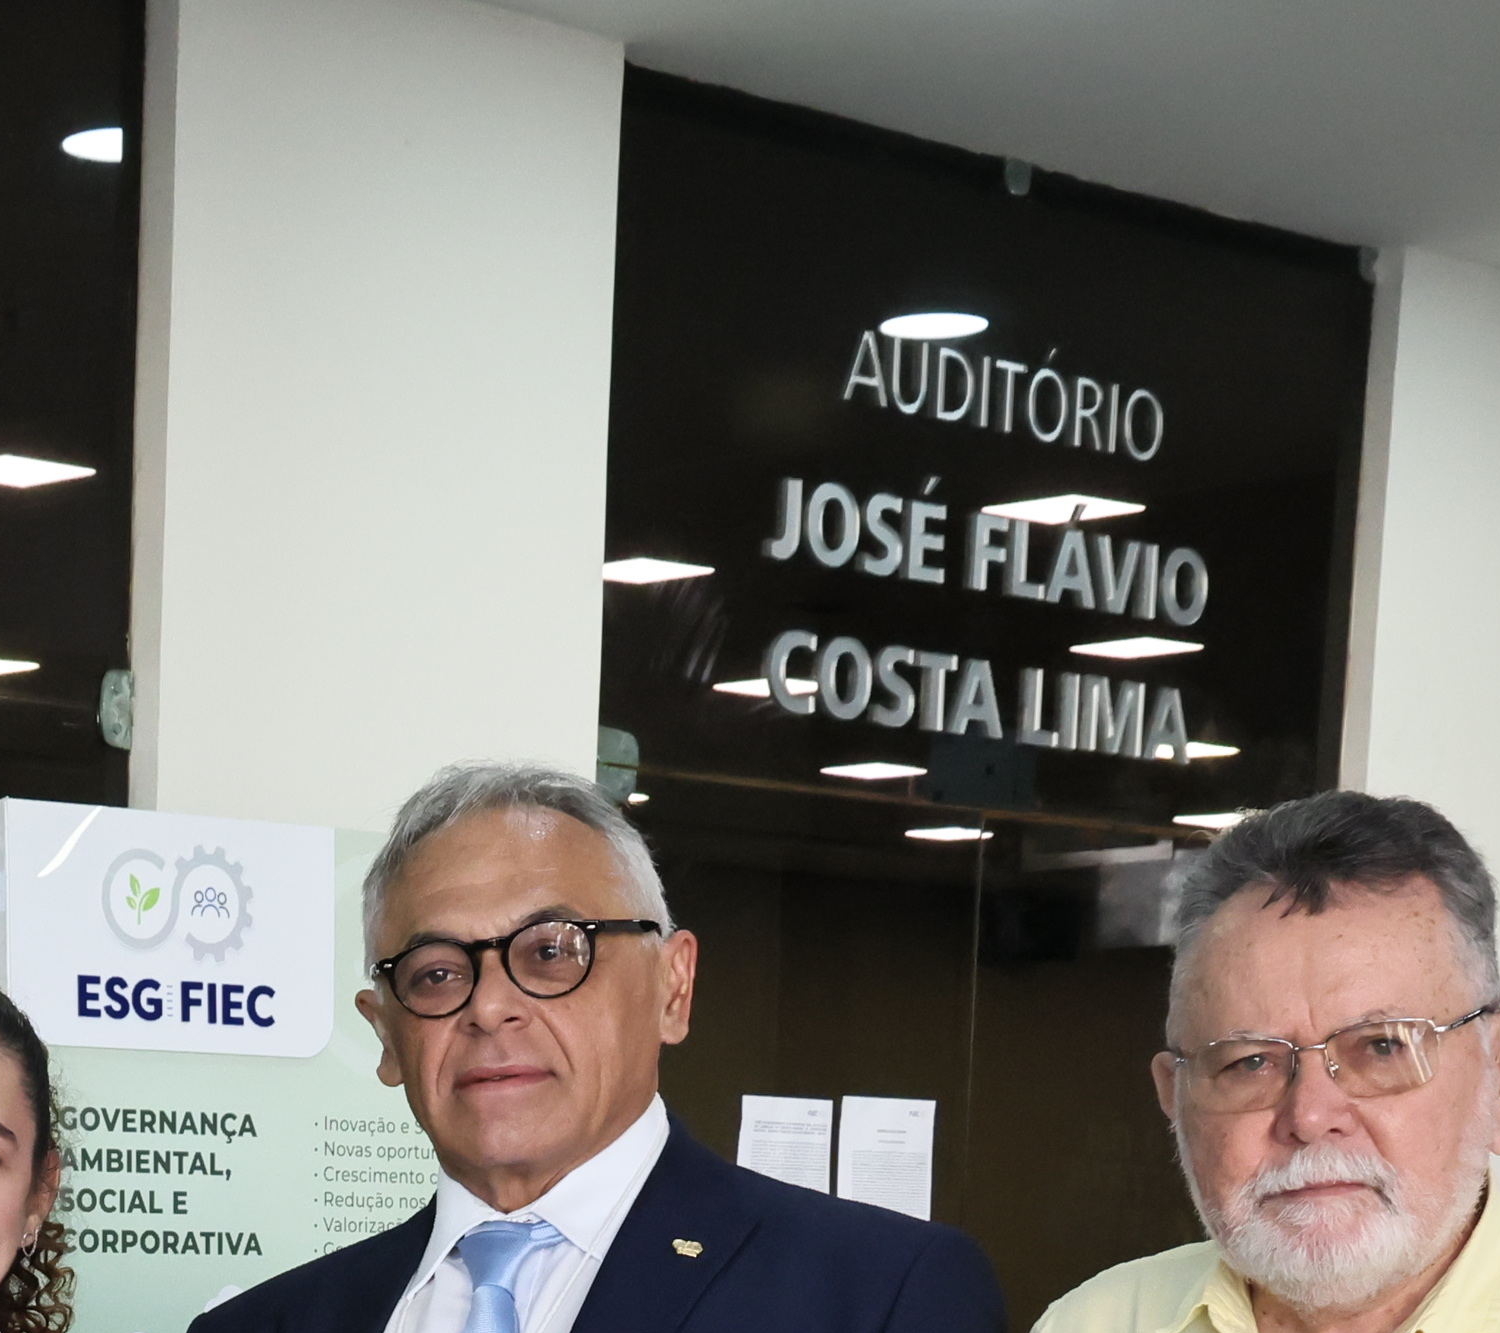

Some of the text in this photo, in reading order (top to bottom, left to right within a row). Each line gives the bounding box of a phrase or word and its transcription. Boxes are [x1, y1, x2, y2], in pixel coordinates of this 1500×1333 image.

[843, 330, 1165, 462] AUDITÓRIO
[763, 475, 1209, 627] JOSÉ FLÁVIO
[765, 629, 1190, 766] COSTA LIMA
[77, 974, 276, 1028] ESG FIEC
[59, 1106, 258, 1144] GOVERNANÇA
[323, 1115, 396, 1137] Inovação
[400, 1122, 410, 1134] e
[60, 1148, 232, 1182] AMBIENTAL,
[323, 1141, 373, 1158] Novas
[323, 1166, 425, 1185] Crescimento
[59, 1187, 189, 1215] SOCIAL E
[323, 1191, 427, 1212] Redução nos
[63, 1228, 263, 1257] CORPORATIVA
